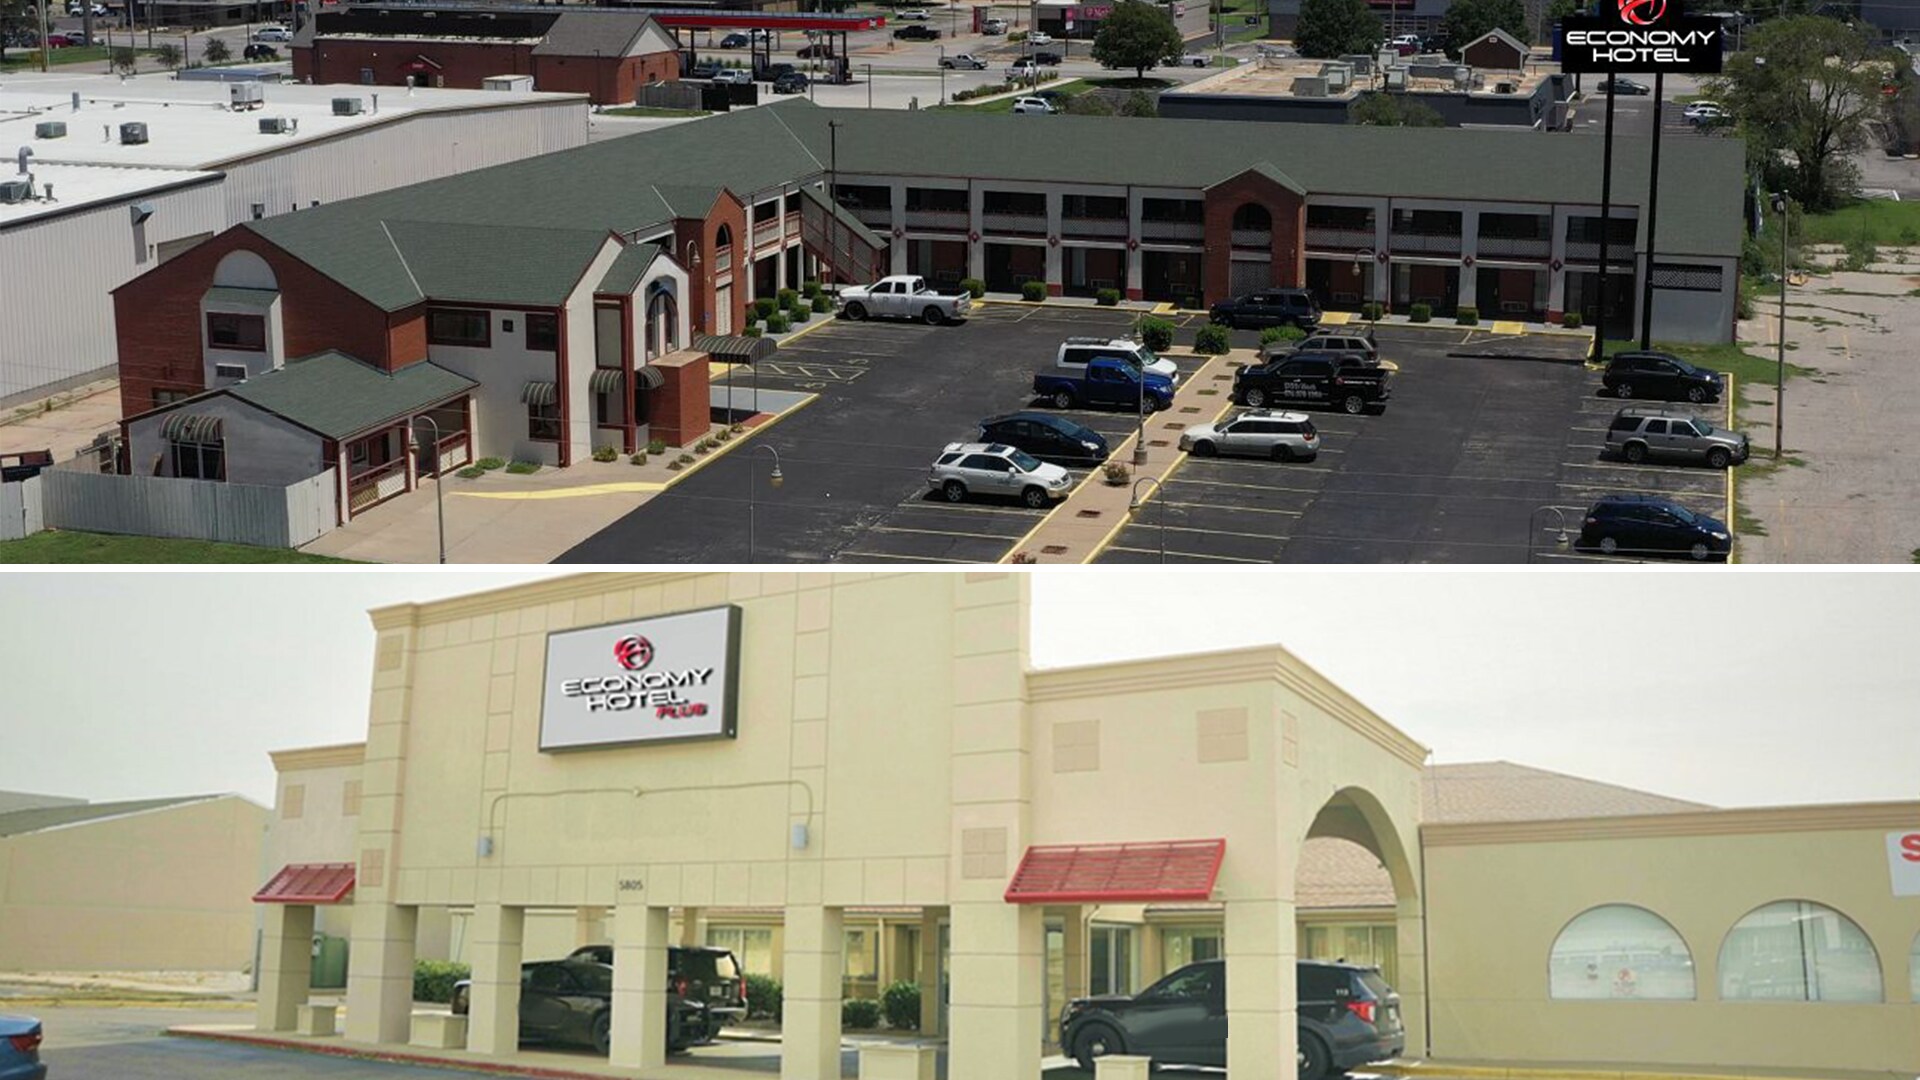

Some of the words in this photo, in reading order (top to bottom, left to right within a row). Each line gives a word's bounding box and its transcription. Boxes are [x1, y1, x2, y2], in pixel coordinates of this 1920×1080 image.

[1566, 31, 1716, 46] ECONOMY
[1592, 48, 1691, 63] HOTEL
[560, 668, 713, 697] ECONOMY
[586, 689, 689, 712] HOTEL
[656, 703, 708, 719] PLUS
[619, 879, 643, 891] 5805
